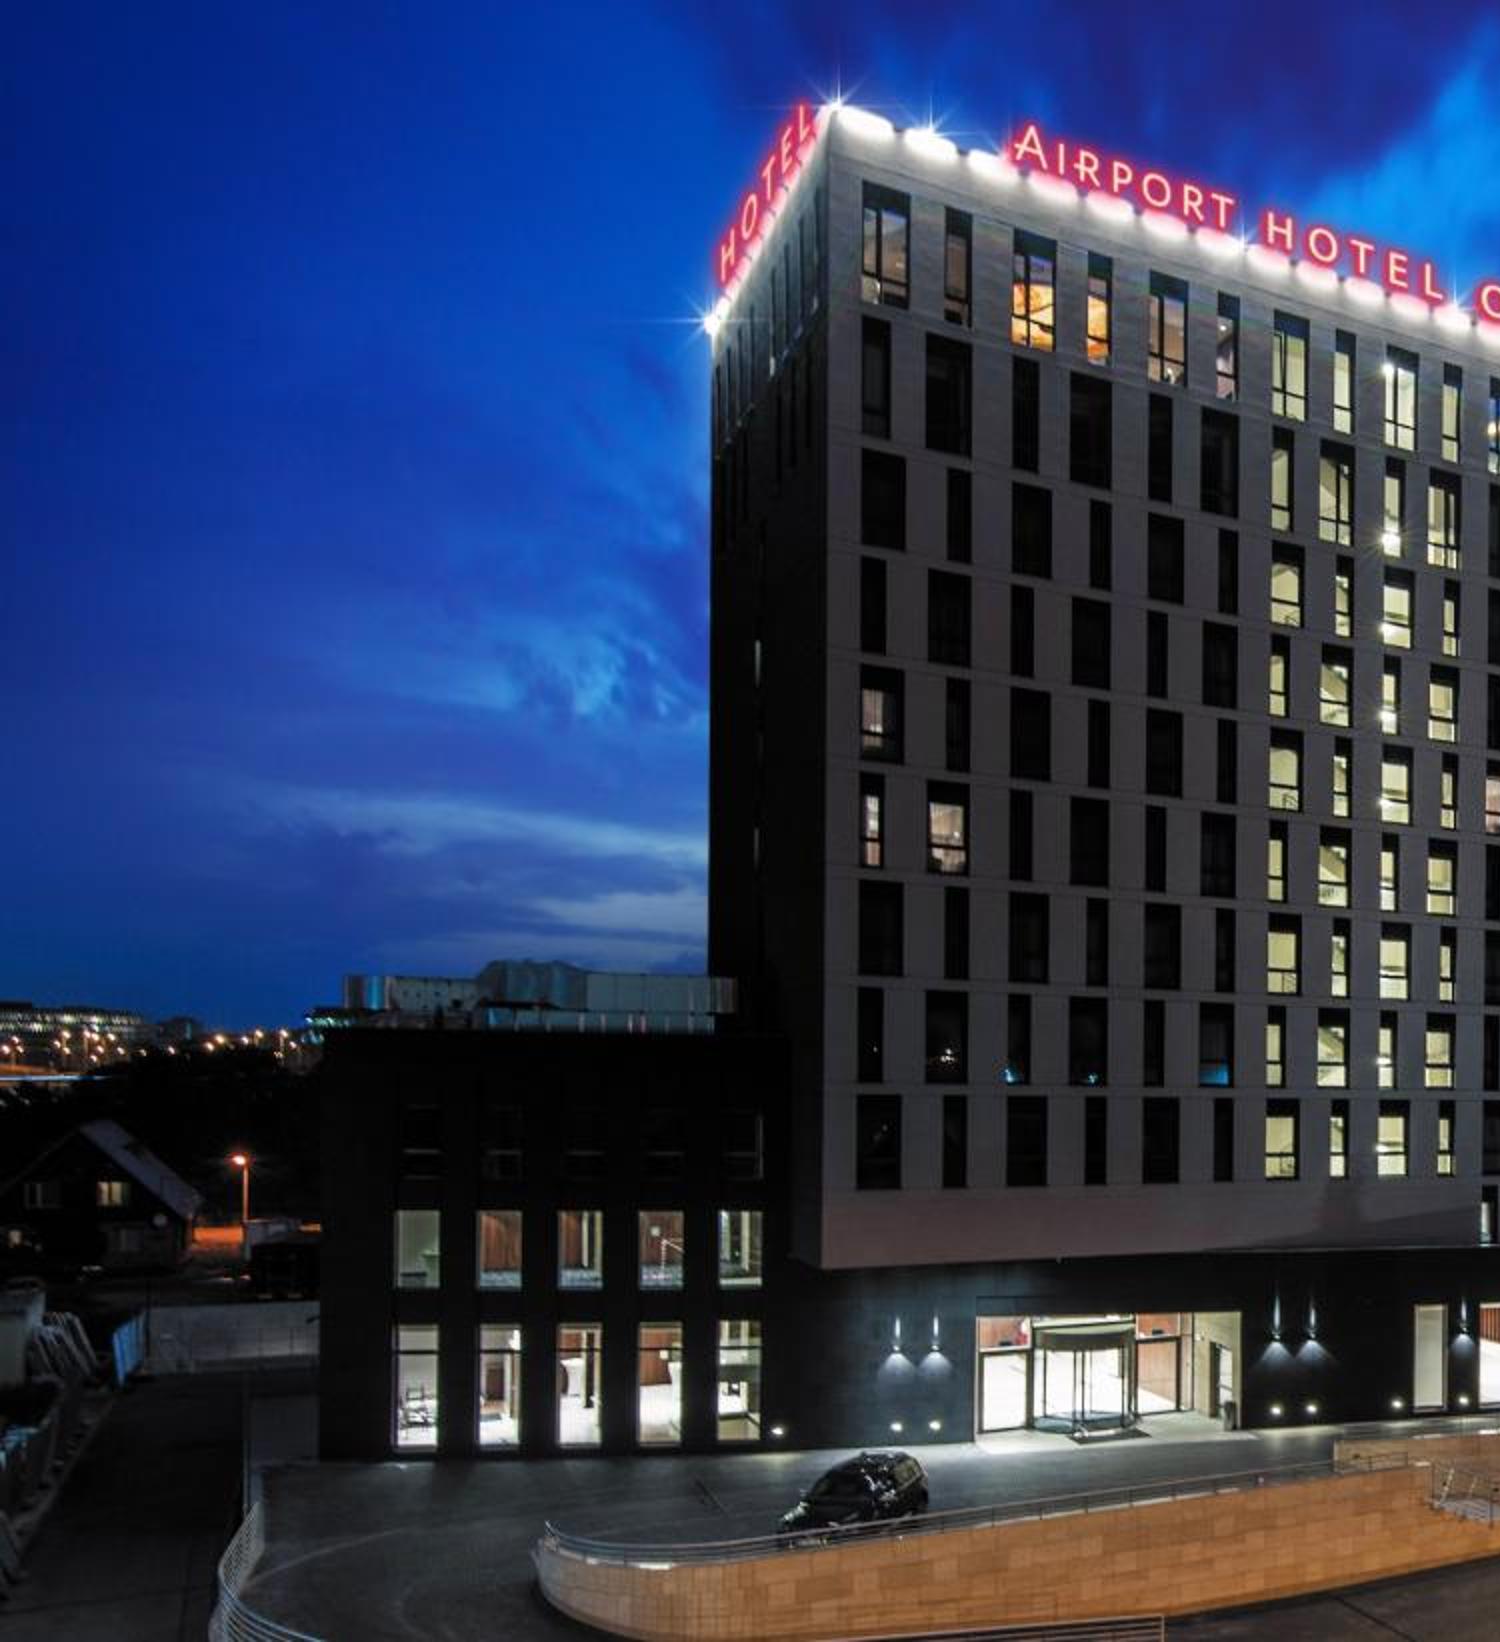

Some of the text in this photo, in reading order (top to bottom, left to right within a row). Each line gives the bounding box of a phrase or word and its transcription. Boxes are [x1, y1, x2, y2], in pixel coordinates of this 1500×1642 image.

[719, 102, 812, 284] HOTEL
[1013, 123, 1236, 229] AIRPORT
[1265, 211, 1444, 300] HOTEL
